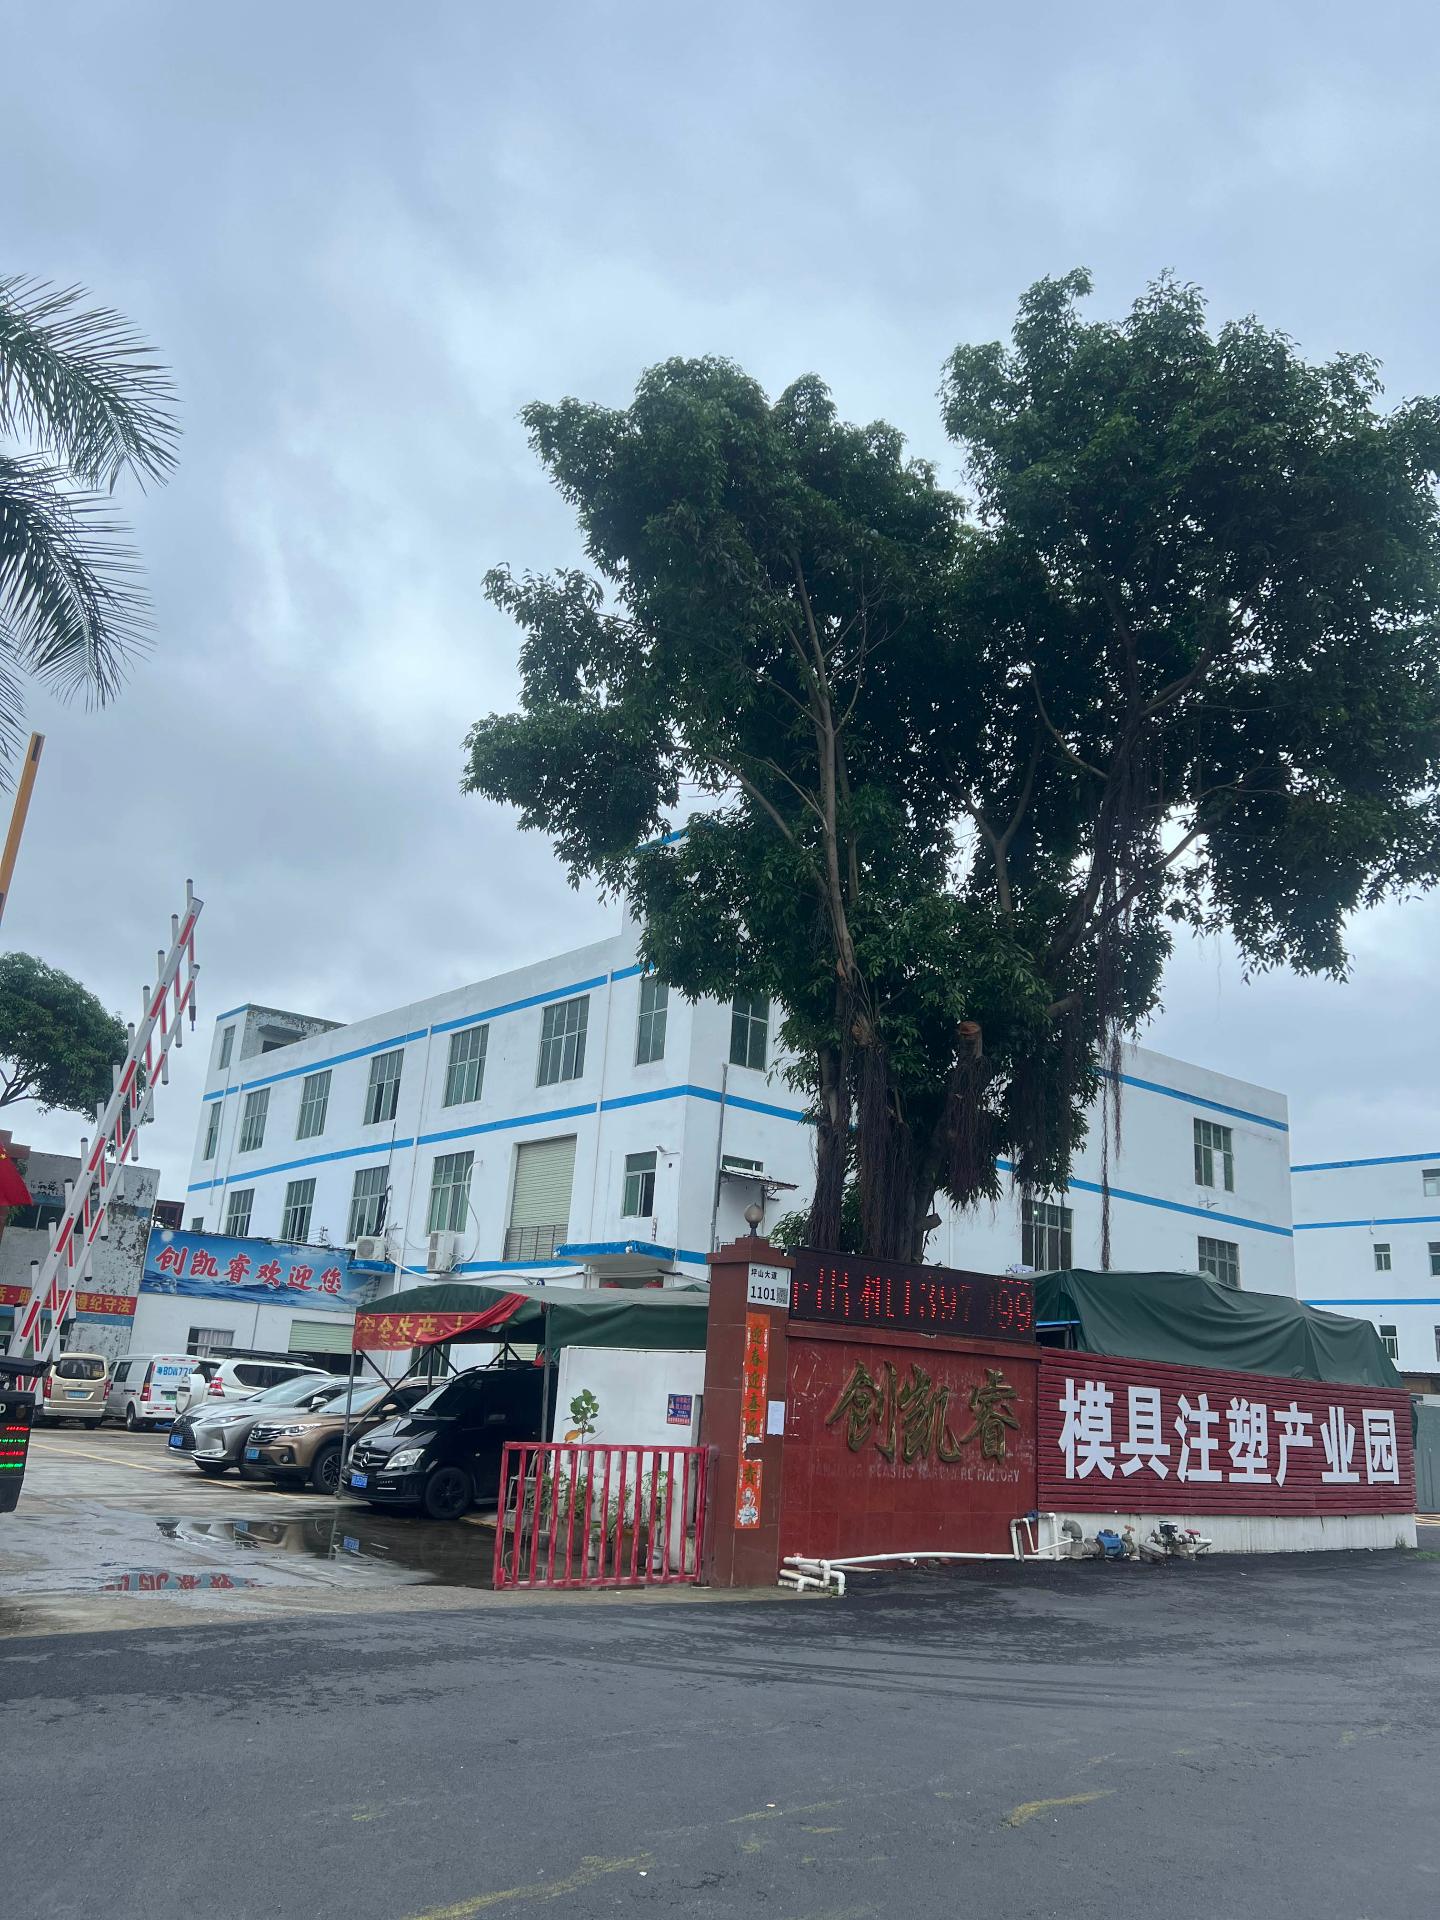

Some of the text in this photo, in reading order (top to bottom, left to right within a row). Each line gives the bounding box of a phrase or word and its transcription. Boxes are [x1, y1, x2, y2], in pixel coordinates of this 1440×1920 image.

[155, 1245, 342, 1294] 创凯睿欢迎您
[751, 1268, 777, 1280] 坪山大道
[750, 1285, 776, 1301] 1101
[1058, 1378, 1399, 1487] 模具注塑产业园
